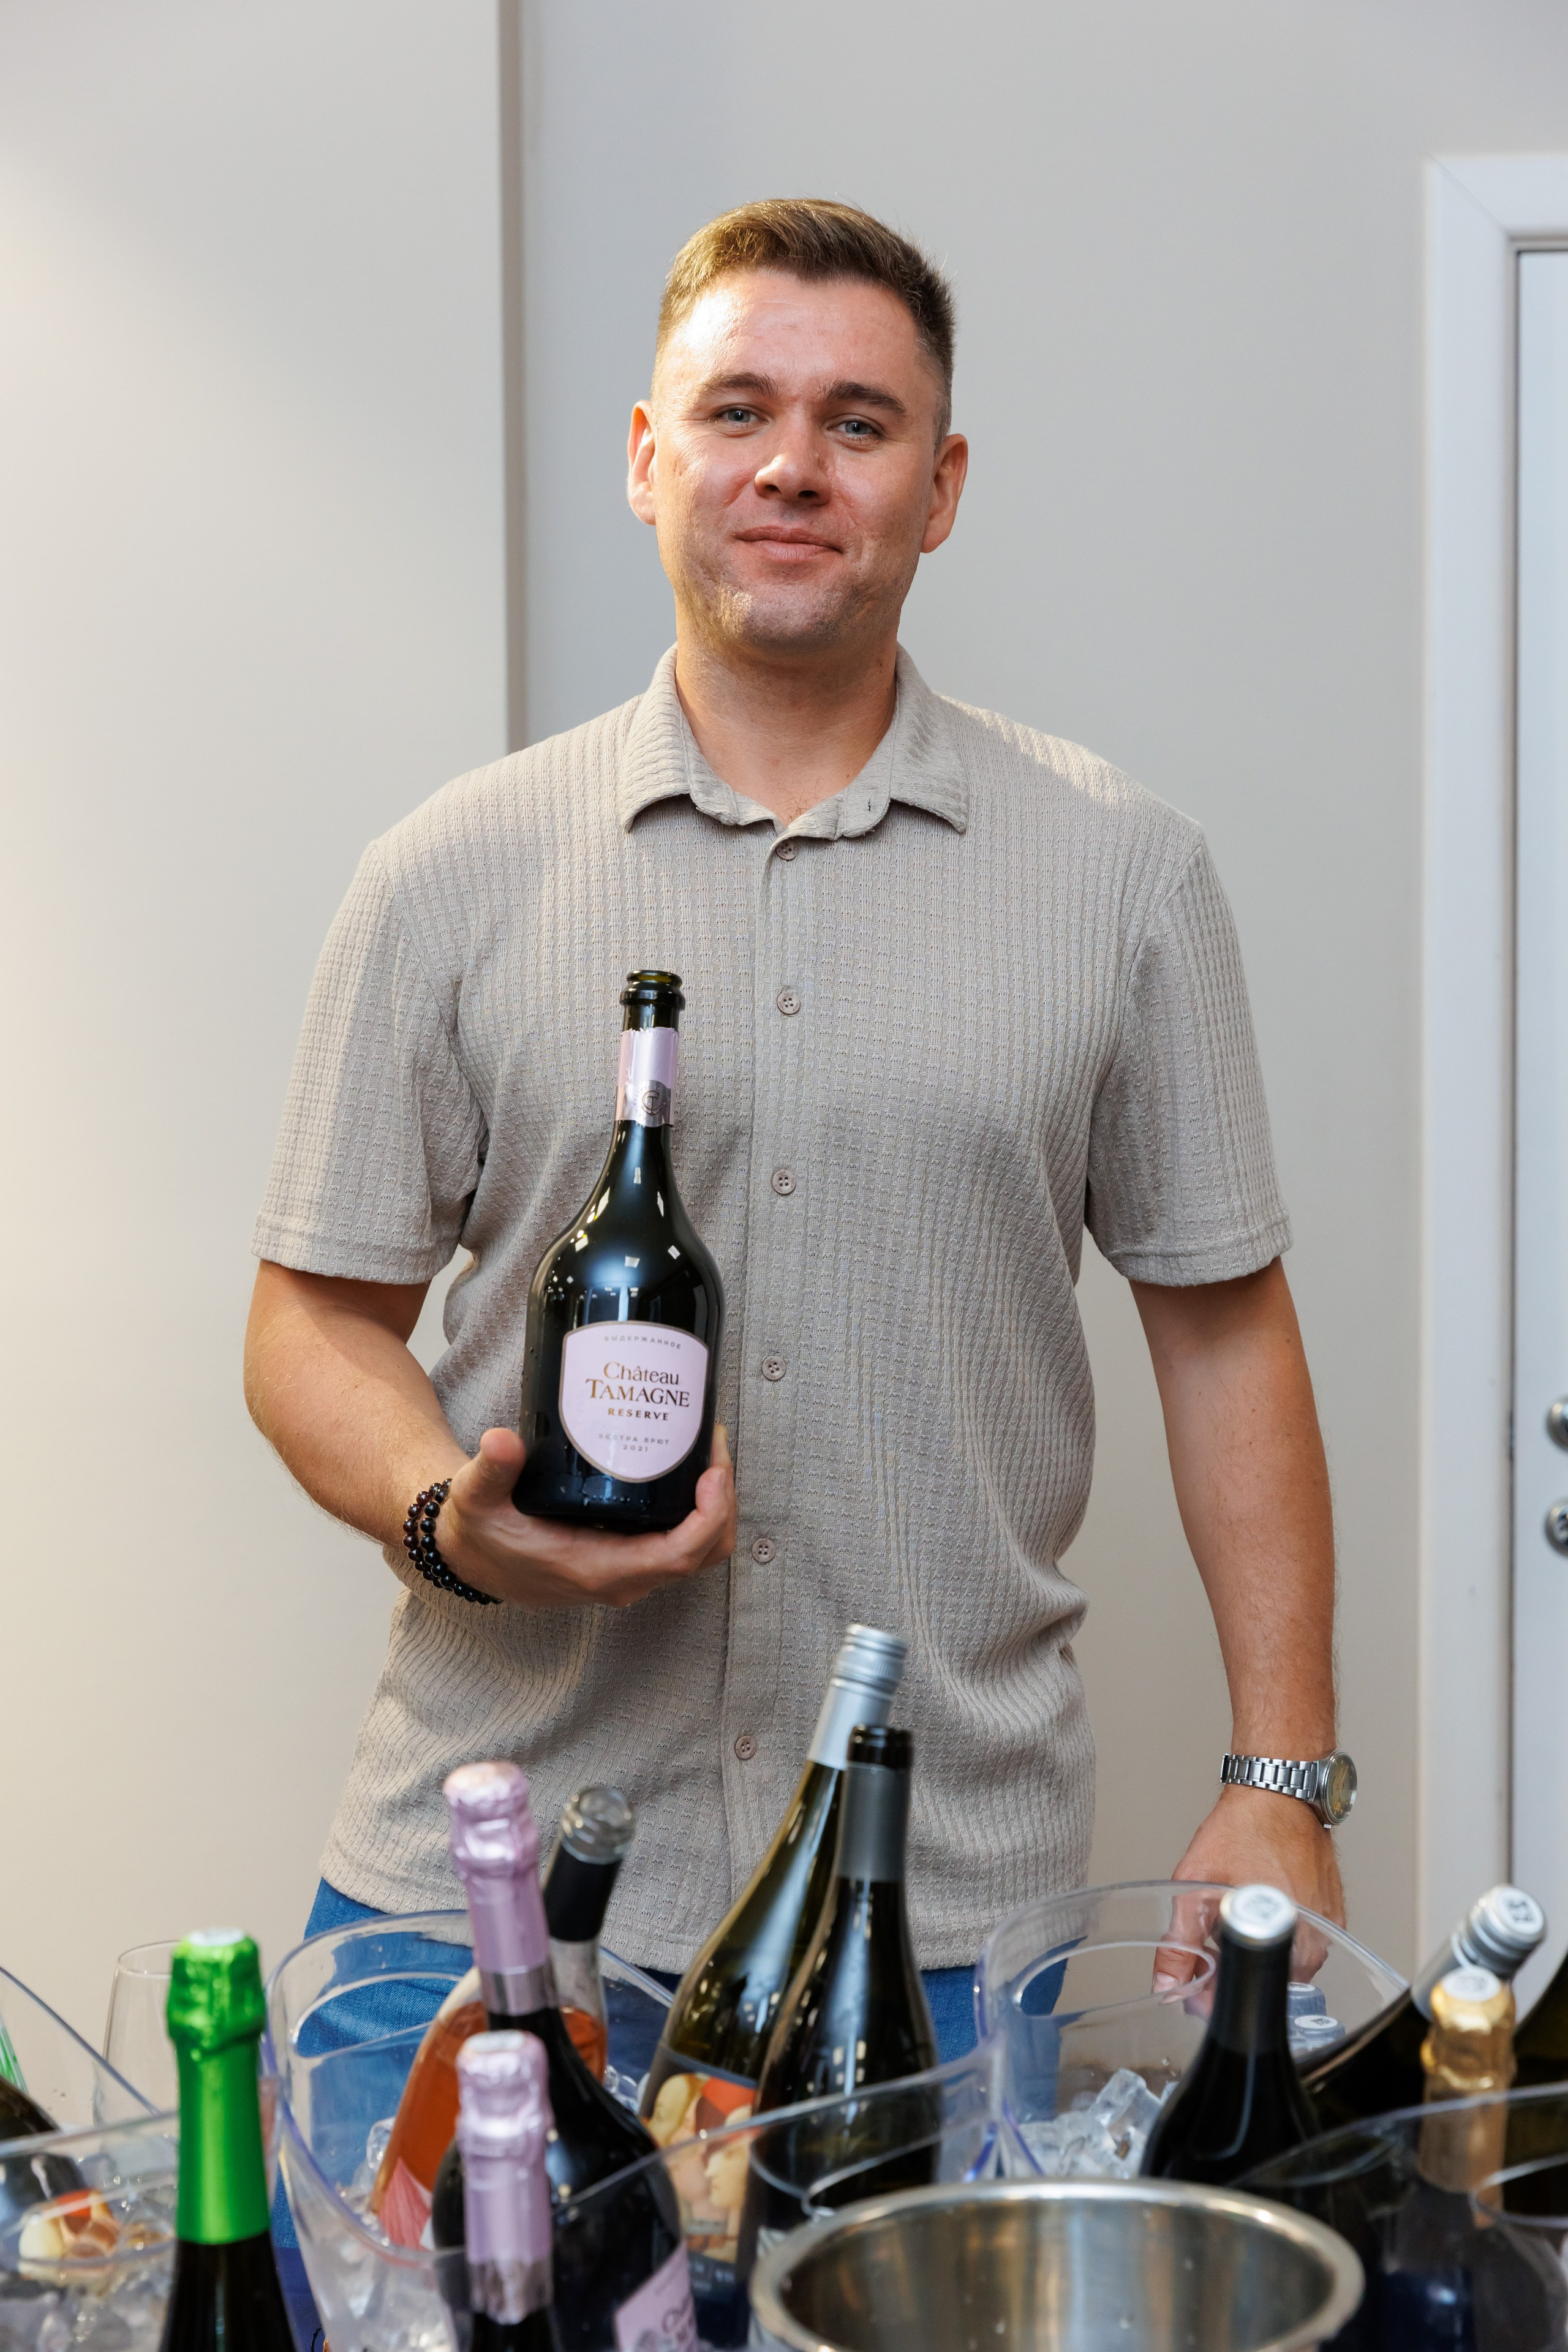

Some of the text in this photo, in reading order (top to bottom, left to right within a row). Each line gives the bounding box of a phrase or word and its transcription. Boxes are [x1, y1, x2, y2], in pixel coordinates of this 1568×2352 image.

[604, 1336, 681, 1349] ВЫДЕРЖАННОЕ
[604, 1362, 679, 1385] Château
[586, 1379, 690, 1407] TAMAGNE
[608, 1408, 668, 1420] RESERVE
[598, 1433, 638, 1442] ЭКСТРА
